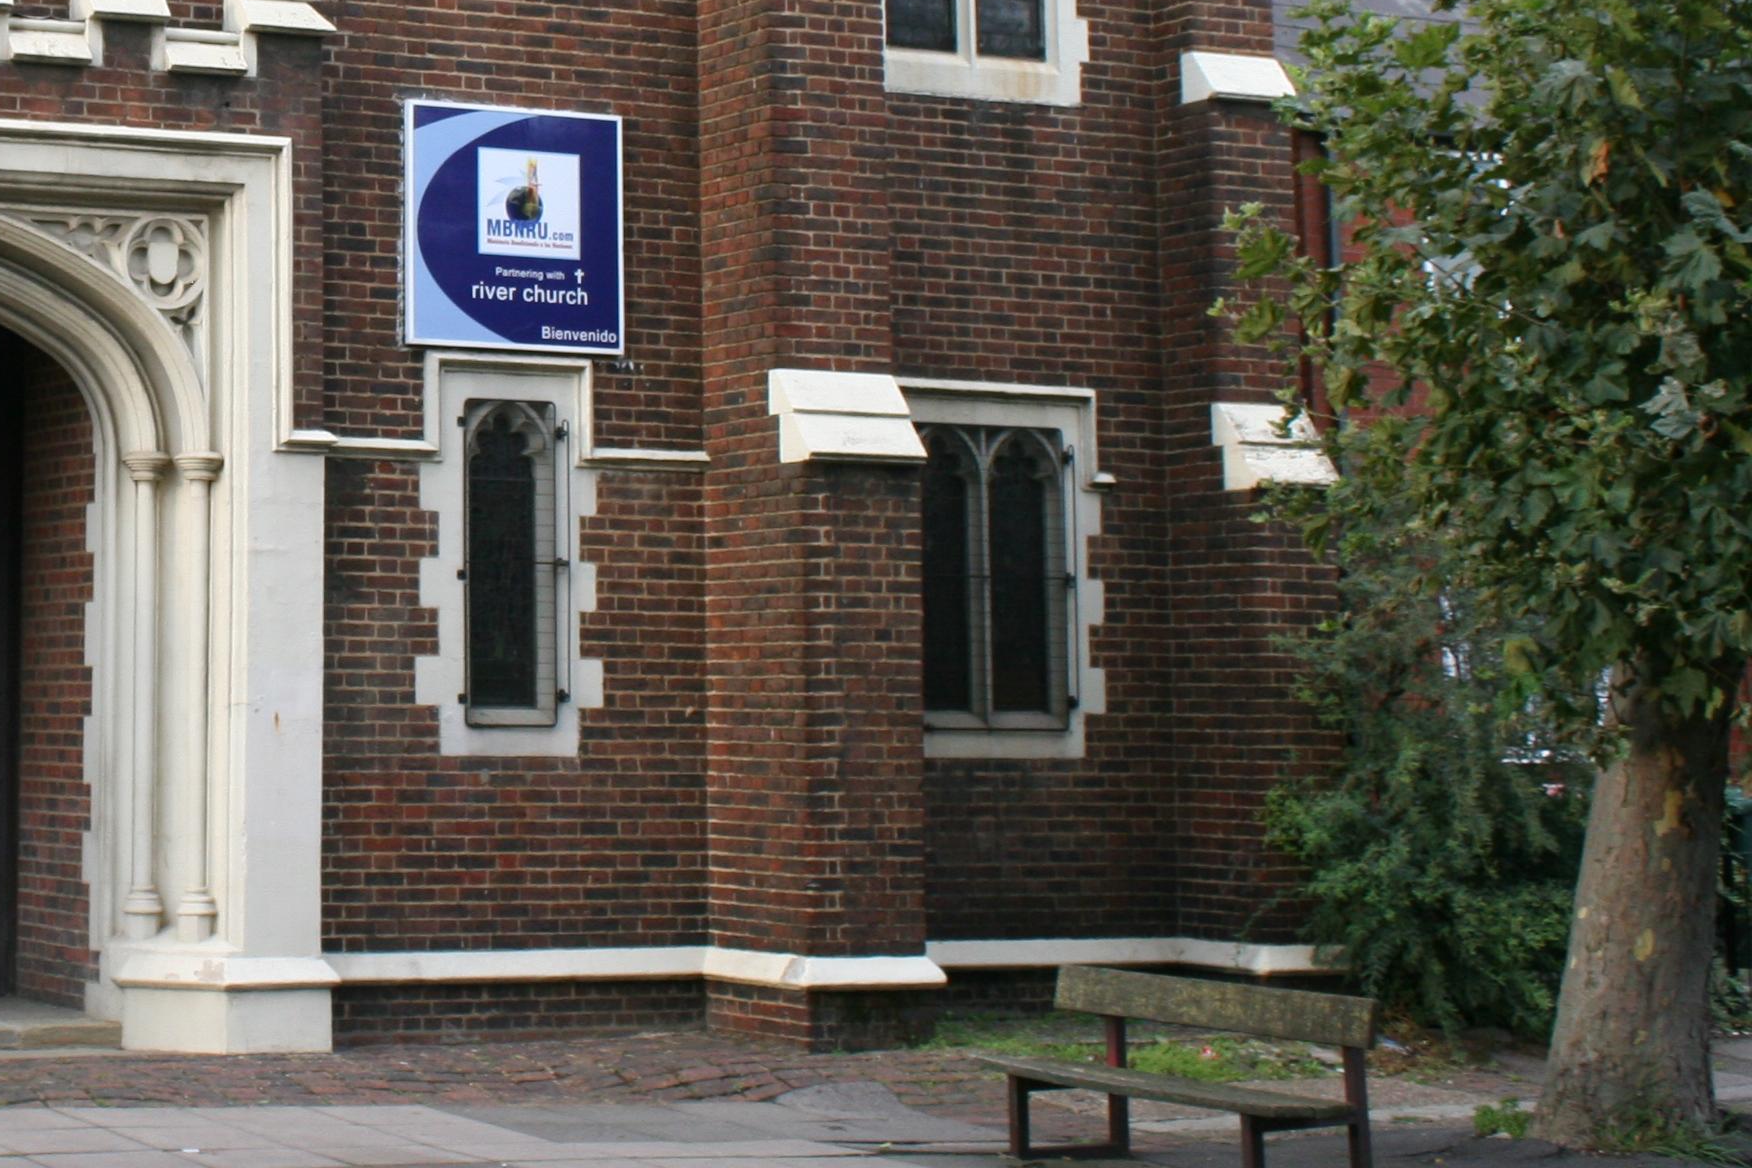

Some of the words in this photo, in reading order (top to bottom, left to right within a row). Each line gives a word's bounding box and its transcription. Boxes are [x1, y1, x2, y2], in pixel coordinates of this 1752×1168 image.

[495, 266, 544, 281] Partnering
[546, 271, 565, 280] with
[471, 281, 517, 301] river
[522, 284, 589, 306] church
[541, 326, 617, 344] Bienvenido
